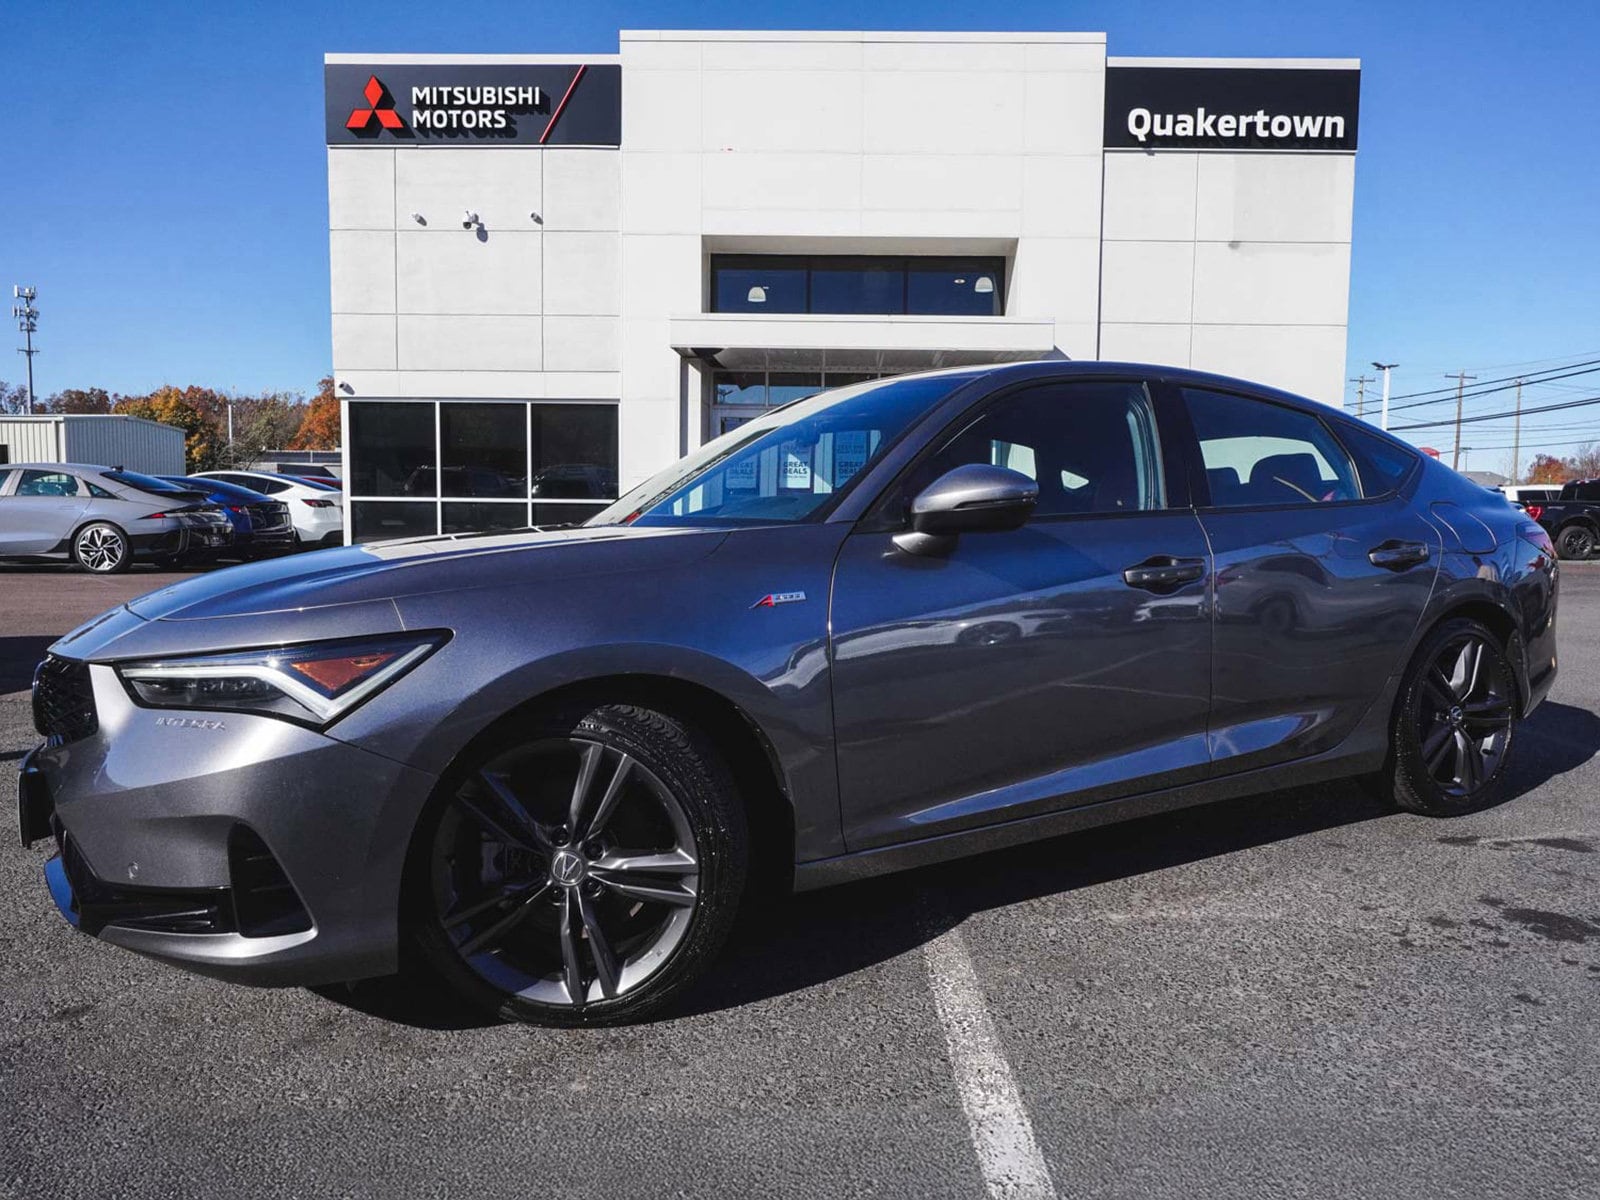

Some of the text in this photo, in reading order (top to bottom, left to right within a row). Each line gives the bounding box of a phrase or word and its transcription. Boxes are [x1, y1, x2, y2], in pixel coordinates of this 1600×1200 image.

[411, 86, 540, 105] MITSUBISHI
[412, 109, 507, 128] MOTORS
[1127, 107, 1345, 142] Quakertown
[783, 467, 808, 475] DEALS
